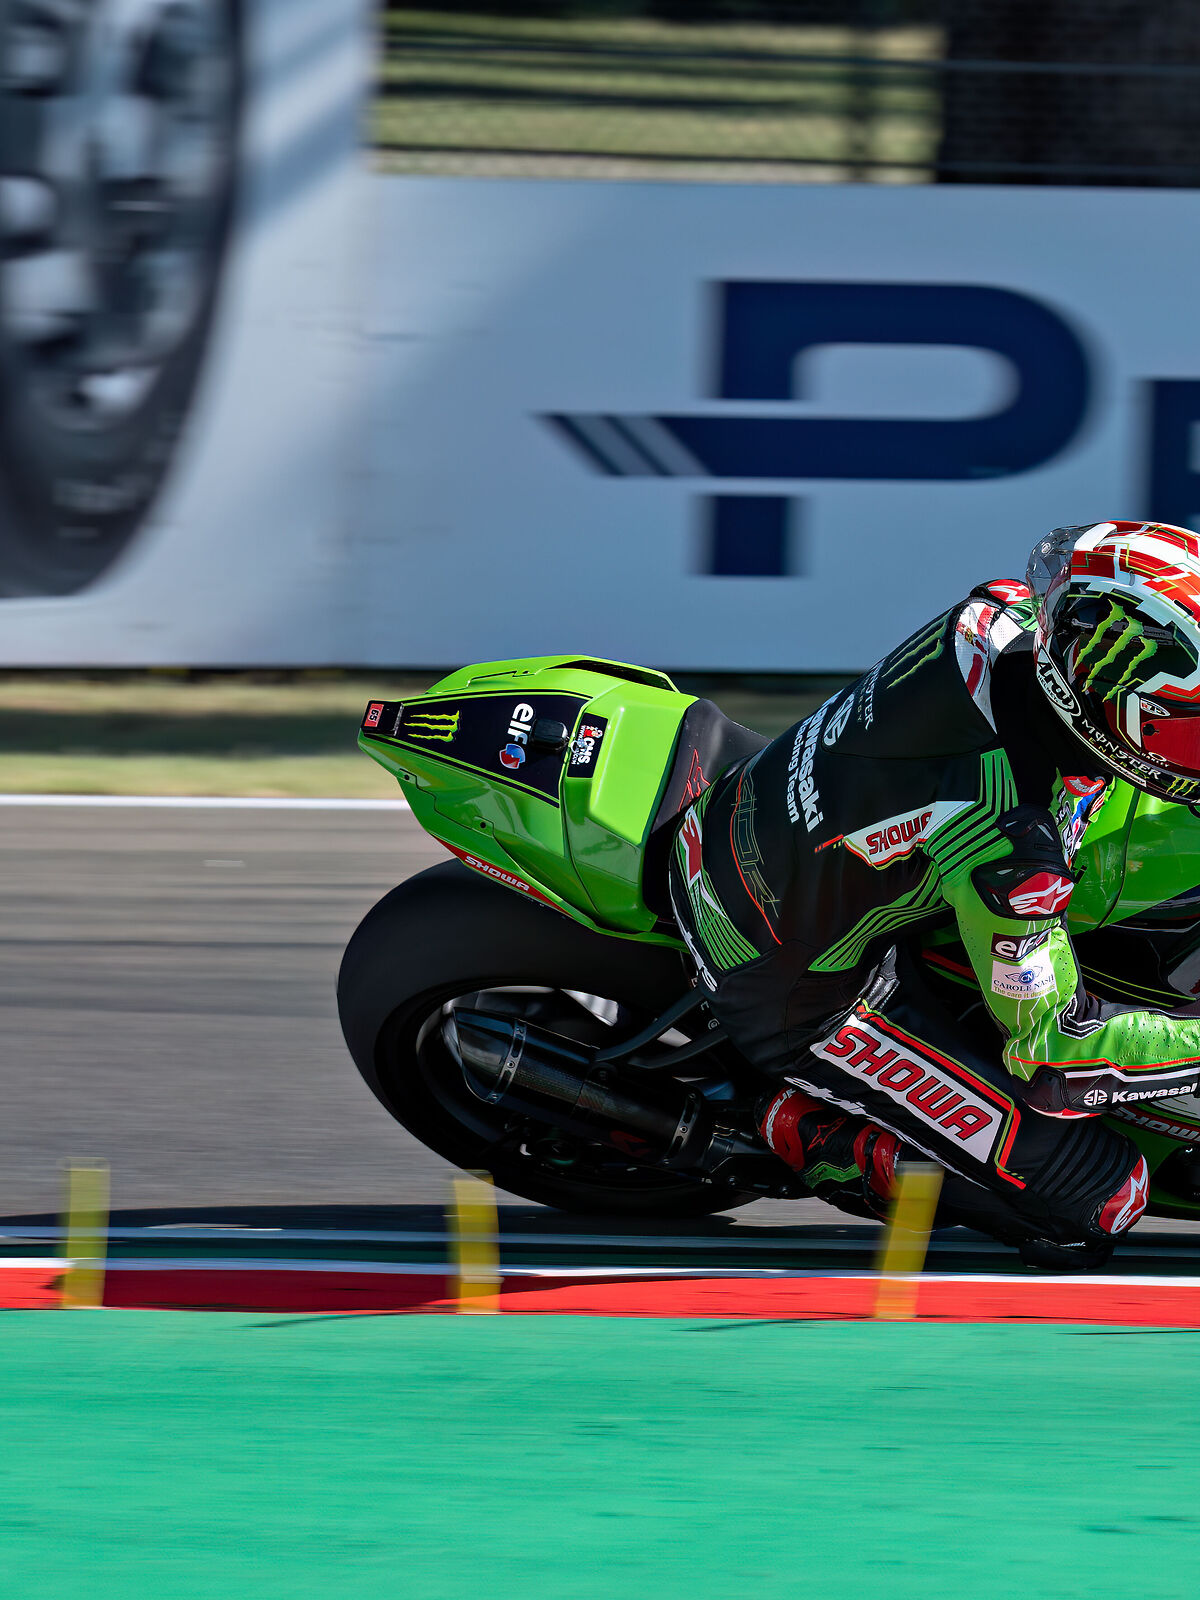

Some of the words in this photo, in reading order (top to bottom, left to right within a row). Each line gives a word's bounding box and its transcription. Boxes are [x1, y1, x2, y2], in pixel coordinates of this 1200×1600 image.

[1037, 661, 1074, 708] Arai
[507, 702, 534, 746] elf
[1082, 718, 1162, 780] MONSTER
[786, 772, 800, 824] Team
[865, 811, 934, 855] SHOWA
[464, 855, 530, 891] SHOWA
[995, 935, 1038, 958] elf
[993, 979, 1032, 992] CAROLE
[993, 986, 1006, 995] The
[823, 1024, 994, 1141] SHOWA
